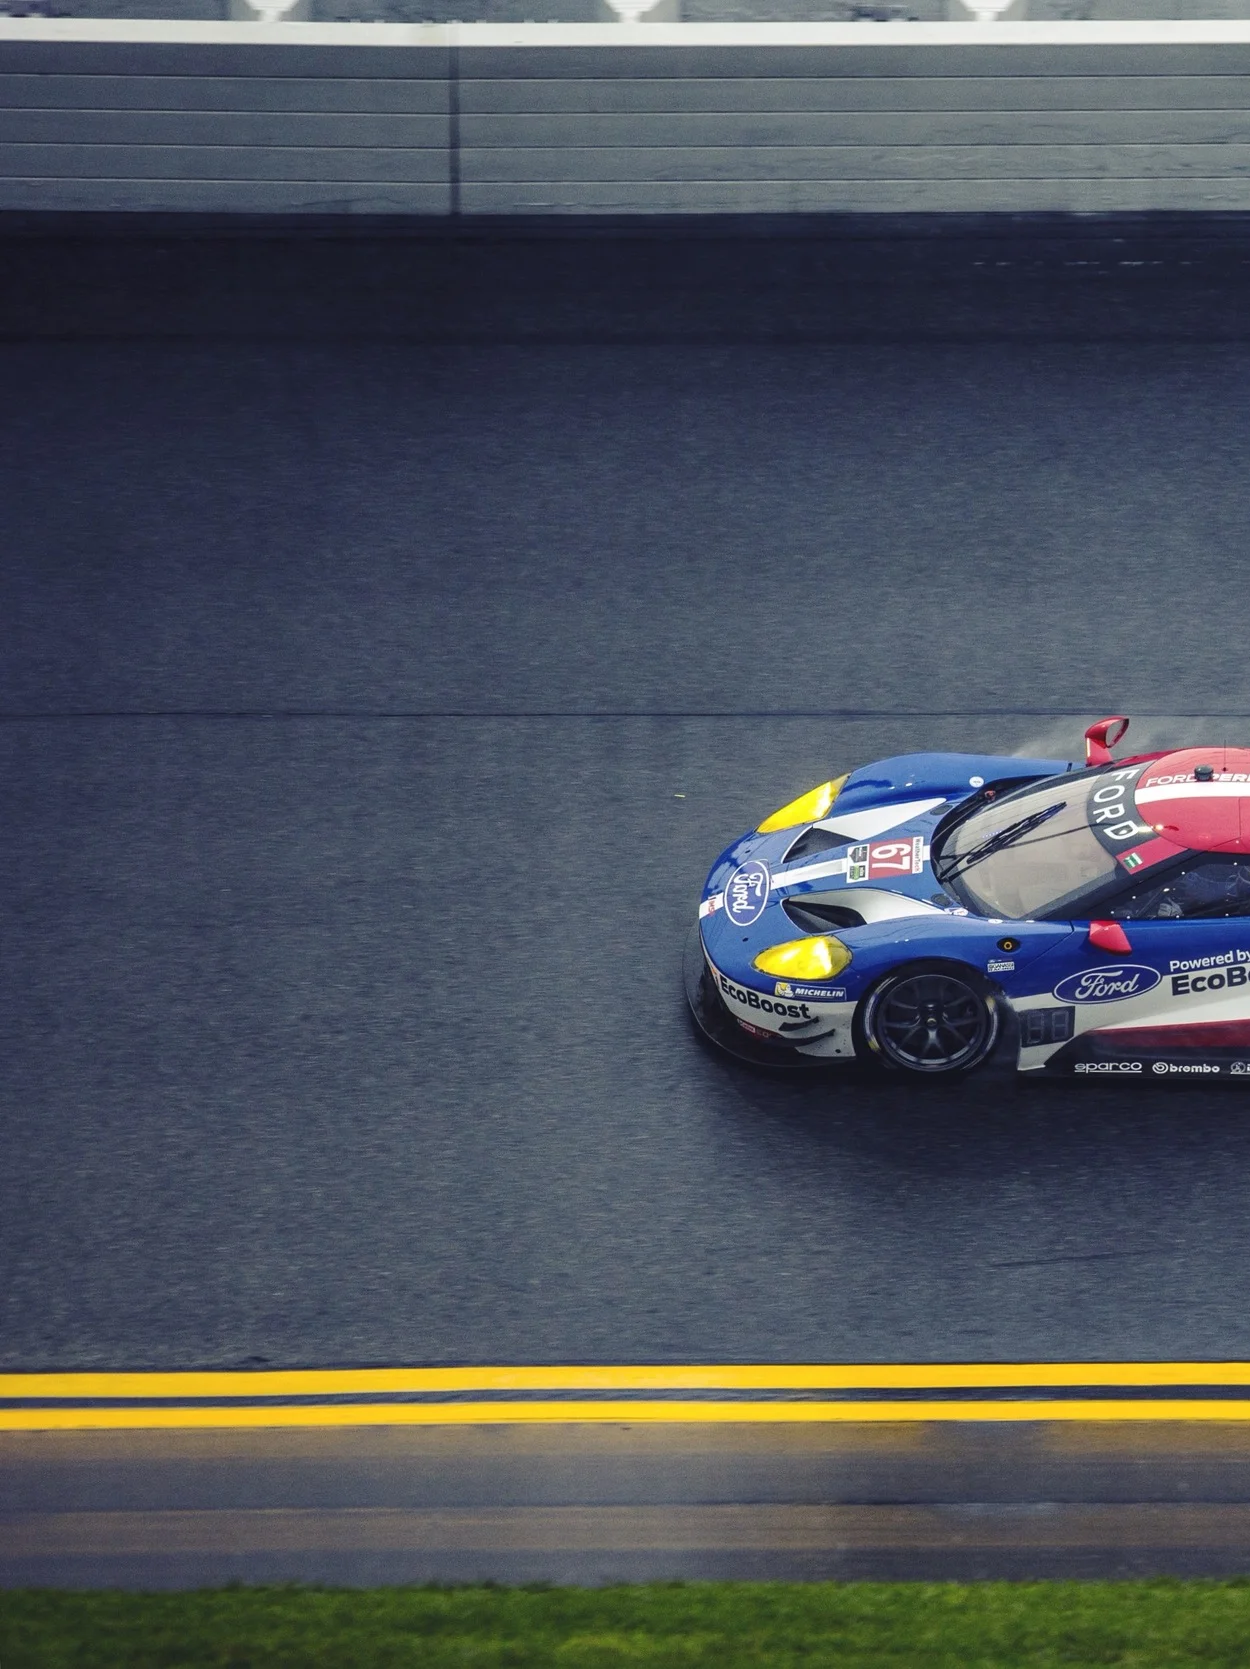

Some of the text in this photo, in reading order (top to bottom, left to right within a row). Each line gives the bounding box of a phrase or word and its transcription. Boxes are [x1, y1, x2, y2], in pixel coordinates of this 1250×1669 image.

[1093, 768, 1140, 840] FORD
[871, 843, 912, 871] 67
[914, 837, 922, 873] WeatherTech
[732, 872, 763, 914] Ford
[1169, 953, 1234, 972] Powered
[720, 974, 811, 1019] EcoBoost
[795, 988, 844, 997] MICHELIN
[1075, 970, 1140, 999] Ford
[1074, 1062, 1143, 1073] sparco
[1169, 1063, 1220, 1073] brembo
